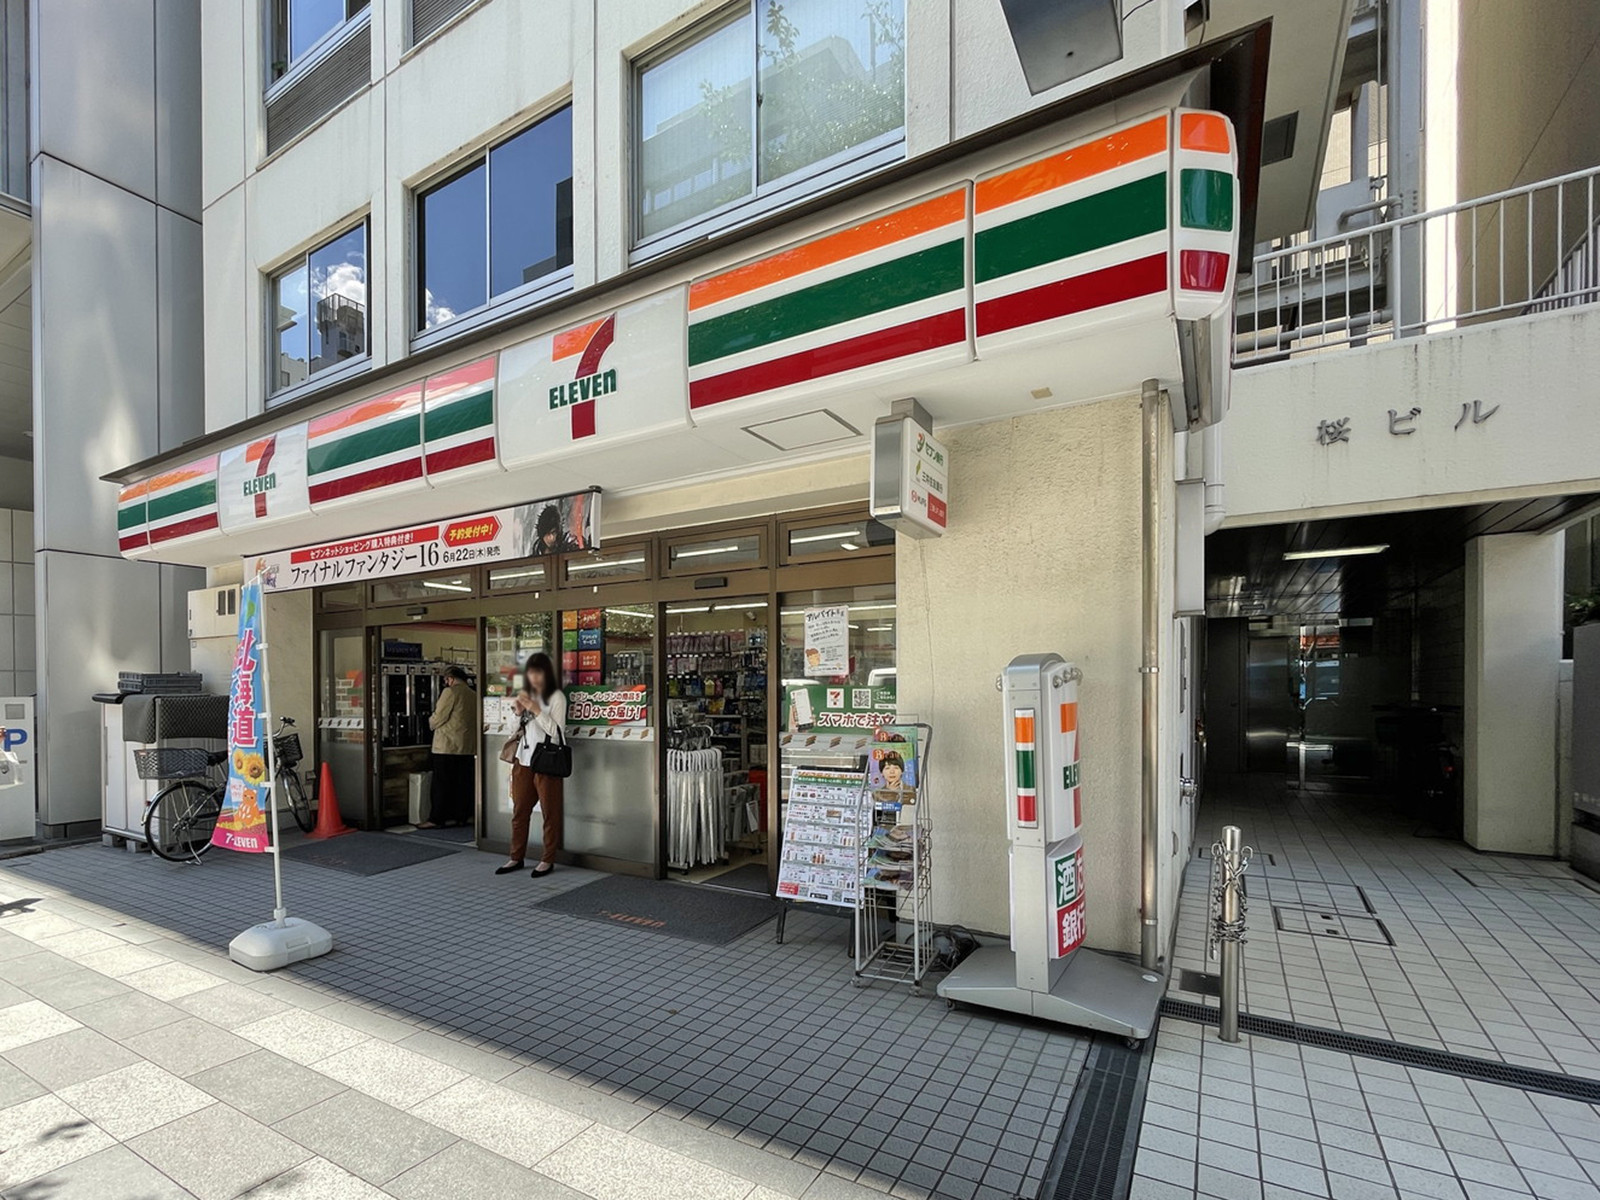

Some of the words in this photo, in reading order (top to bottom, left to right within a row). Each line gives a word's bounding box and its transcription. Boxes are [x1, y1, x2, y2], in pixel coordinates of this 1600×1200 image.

[552, 311, 617, 440] 7
[1316, 400, 1501, 446] 桜ビル
[245, 433, 277, 518] 7
[291, 541, 439, 585] ファイナルファンタジー16
[232, 627, 258, 748] 北海道
[4, 728, 28, 752] P
[1057, 857, 1076, 906] 酒
